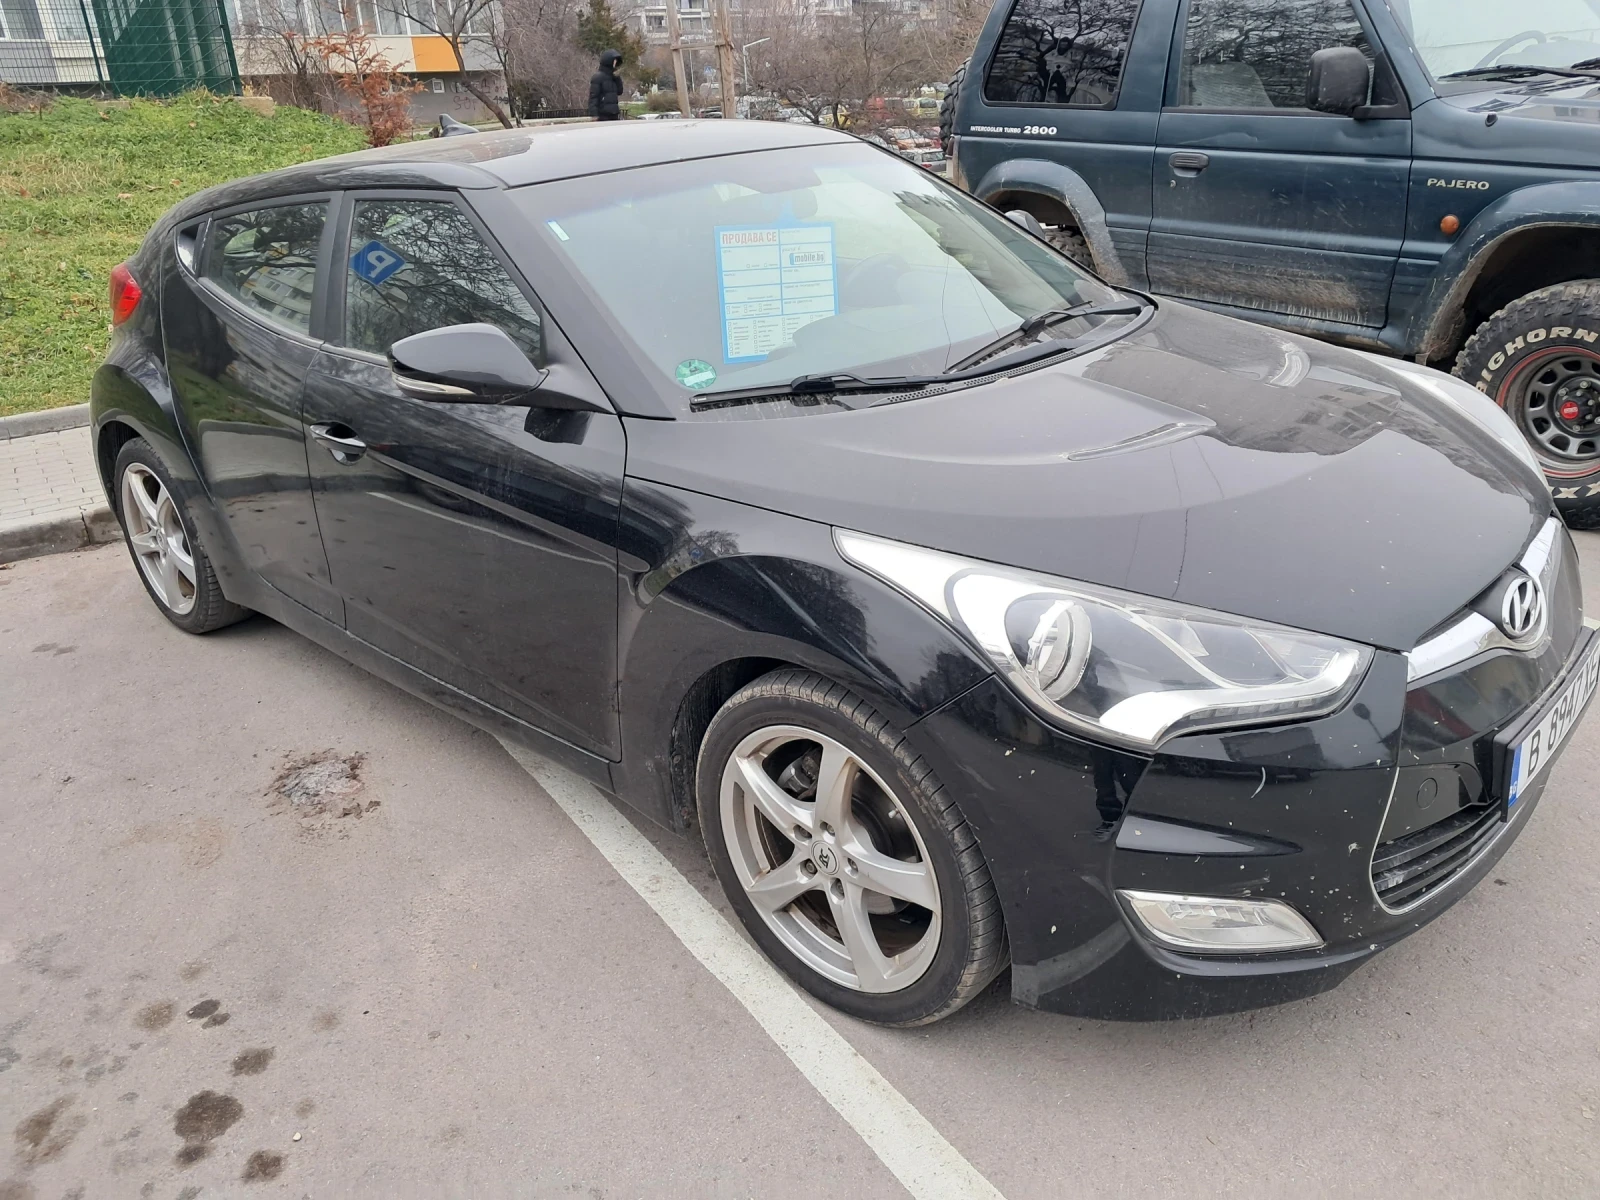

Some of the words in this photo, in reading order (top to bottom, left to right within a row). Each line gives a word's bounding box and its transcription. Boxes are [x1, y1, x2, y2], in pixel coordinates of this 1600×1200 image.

[970, 125, 1003, 133] INTERCOOLER
[1004, 126, 1021, 134] TURBO
[1023, 125, 1057, 135] 2800
[1427, 178, 1490, 190] PAJERO
[722, 232, 764, 245] ПРОДАВА
[766, 231, 777, 242] СЕ
[794, 252, 824, 263] mobile.bg
[1527, 731, 1541, 780] B
[1548, 671, 1584, 751] 8947
